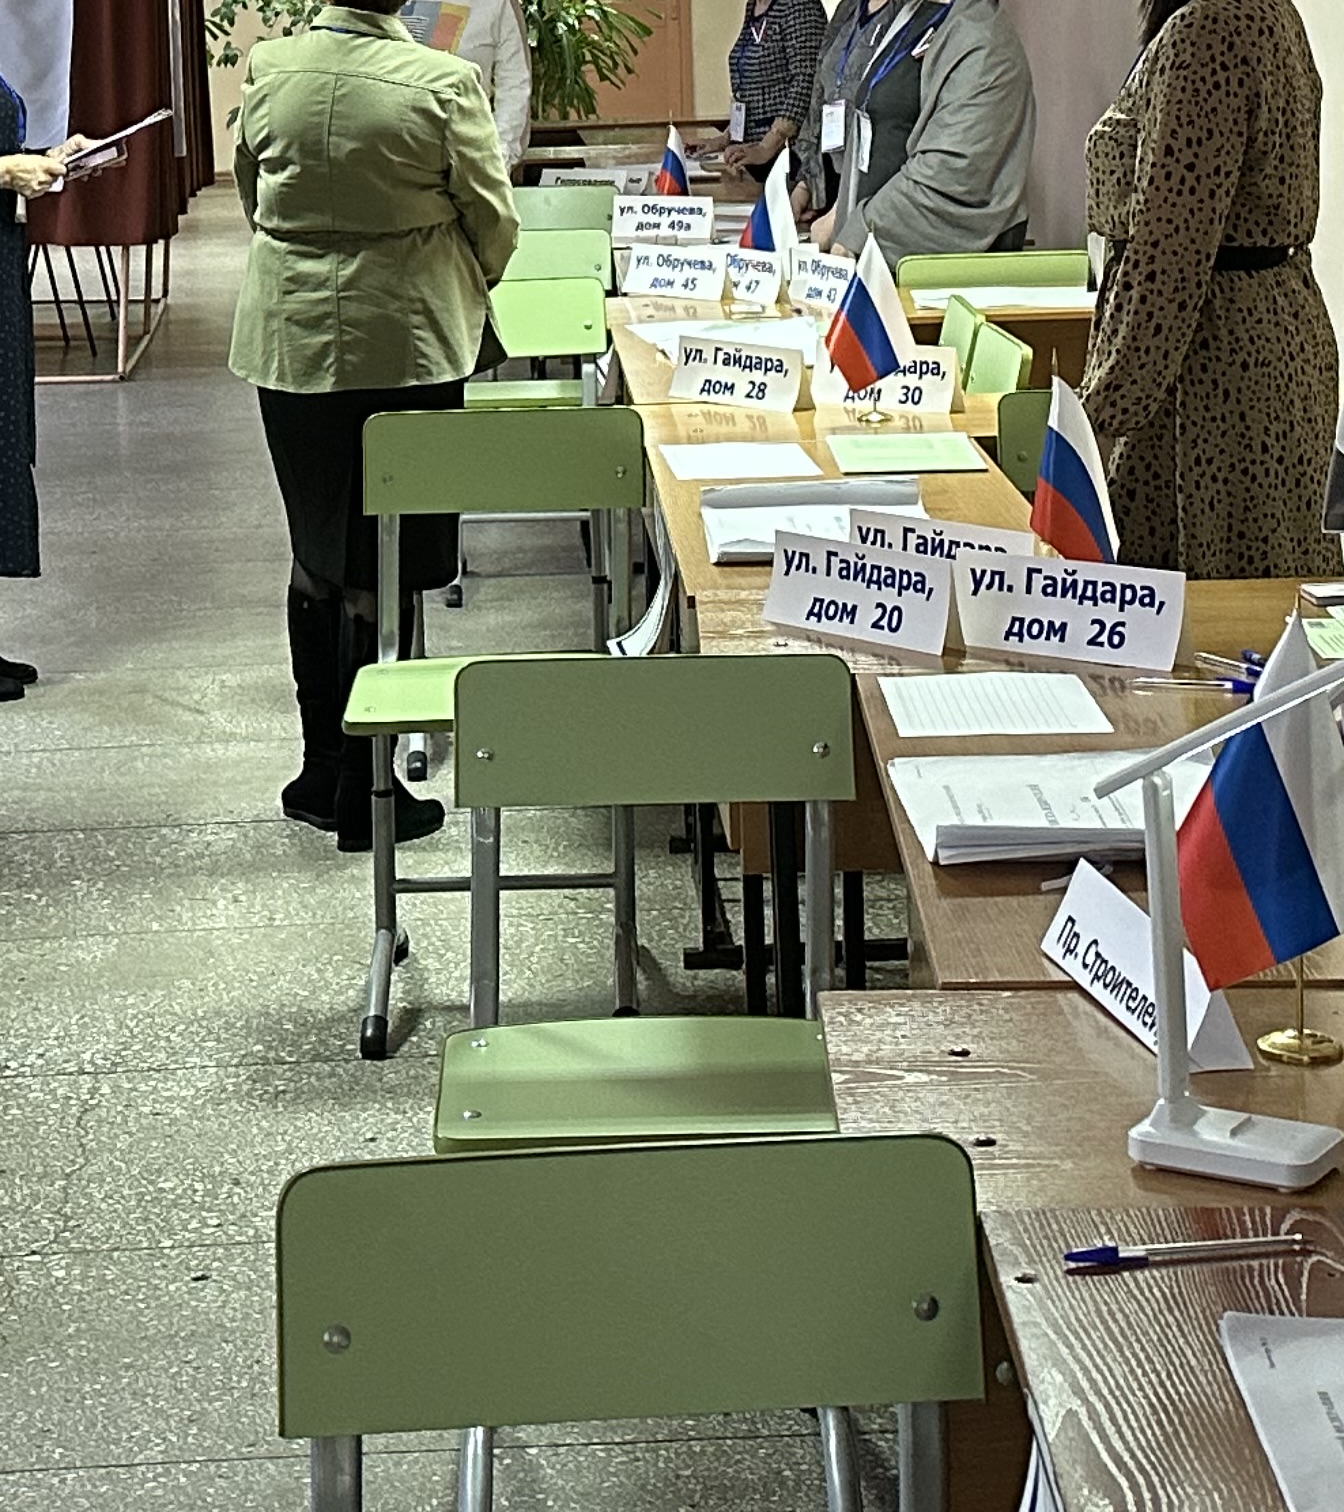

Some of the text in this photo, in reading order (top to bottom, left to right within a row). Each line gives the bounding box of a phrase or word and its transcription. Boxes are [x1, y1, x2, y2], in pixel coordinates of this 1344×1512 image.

[618, 203, 707, 218] ул. Обручева,
[635, 220, 692, 232] дом 49а
[635, 253, 717, 274] ул. Обручева,
[649, 277, 698, 291] дом 45
[745, 280, 761, 294] 47
[683, 346, 789, 378] ул. Гайдара,
[895, 359, 947, 381] ара,
[699, 378, 767, 400] дом 28
[898, 385, 923, 406] 30
[857, 525, 893, 550] ул.
[782, 548, 935, 601] ул. Гайдара,
[970, 566, 1167, 616] ул. Гайдара,
[805, 596, 903, 633] дом 20
[1003, 615, 1127, 649] дом 26
[1056, 915, 1081, 961] Пр.
